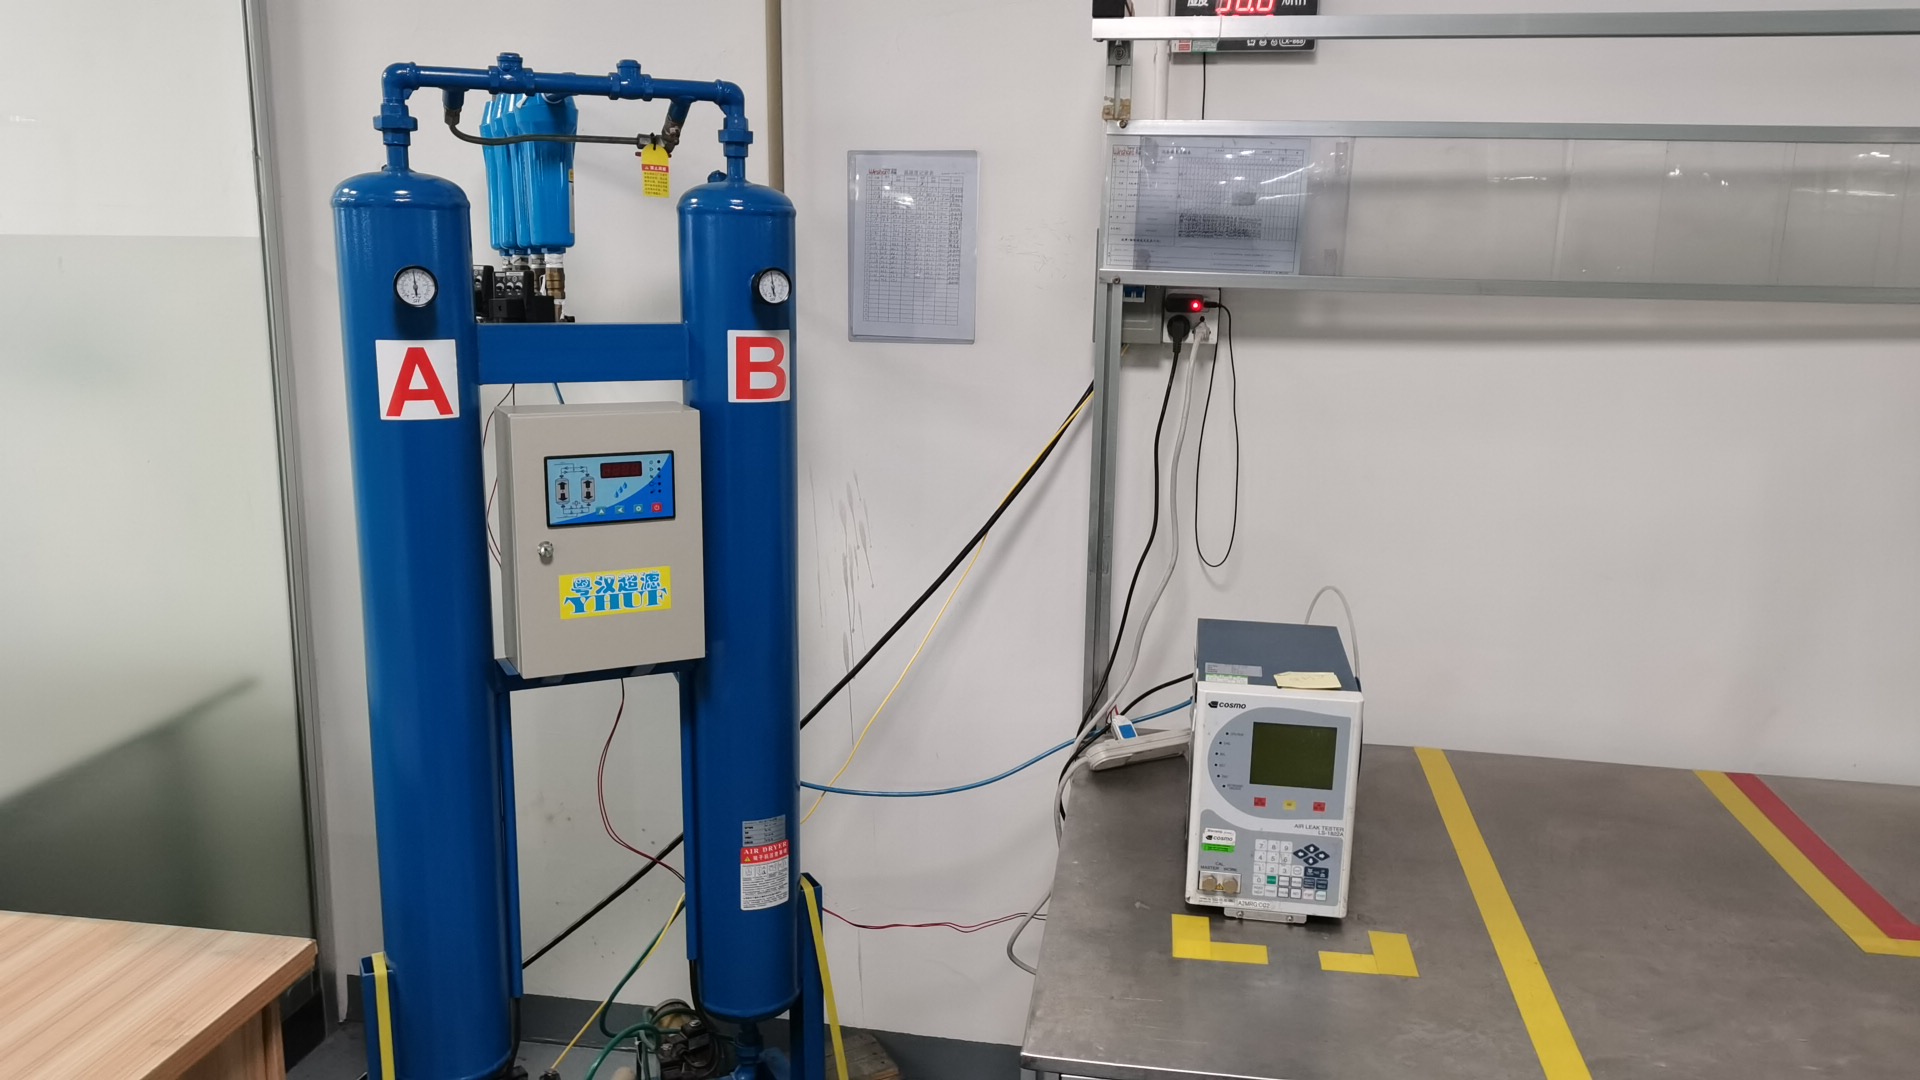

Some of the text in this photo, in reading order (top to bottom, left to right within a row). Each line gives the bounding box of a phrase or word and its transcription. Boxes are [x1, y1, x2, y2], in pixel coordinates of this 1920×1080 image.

[385, 346, 454, 417] A
[735, 336, 787, 400] B
[570, 570, 661, 597] 粤汉超滤
[563, 588, 668, 615] YHUF
[1219, 701, 1247, 710] cosmo
[762, 841, 788, 853] DRYER
